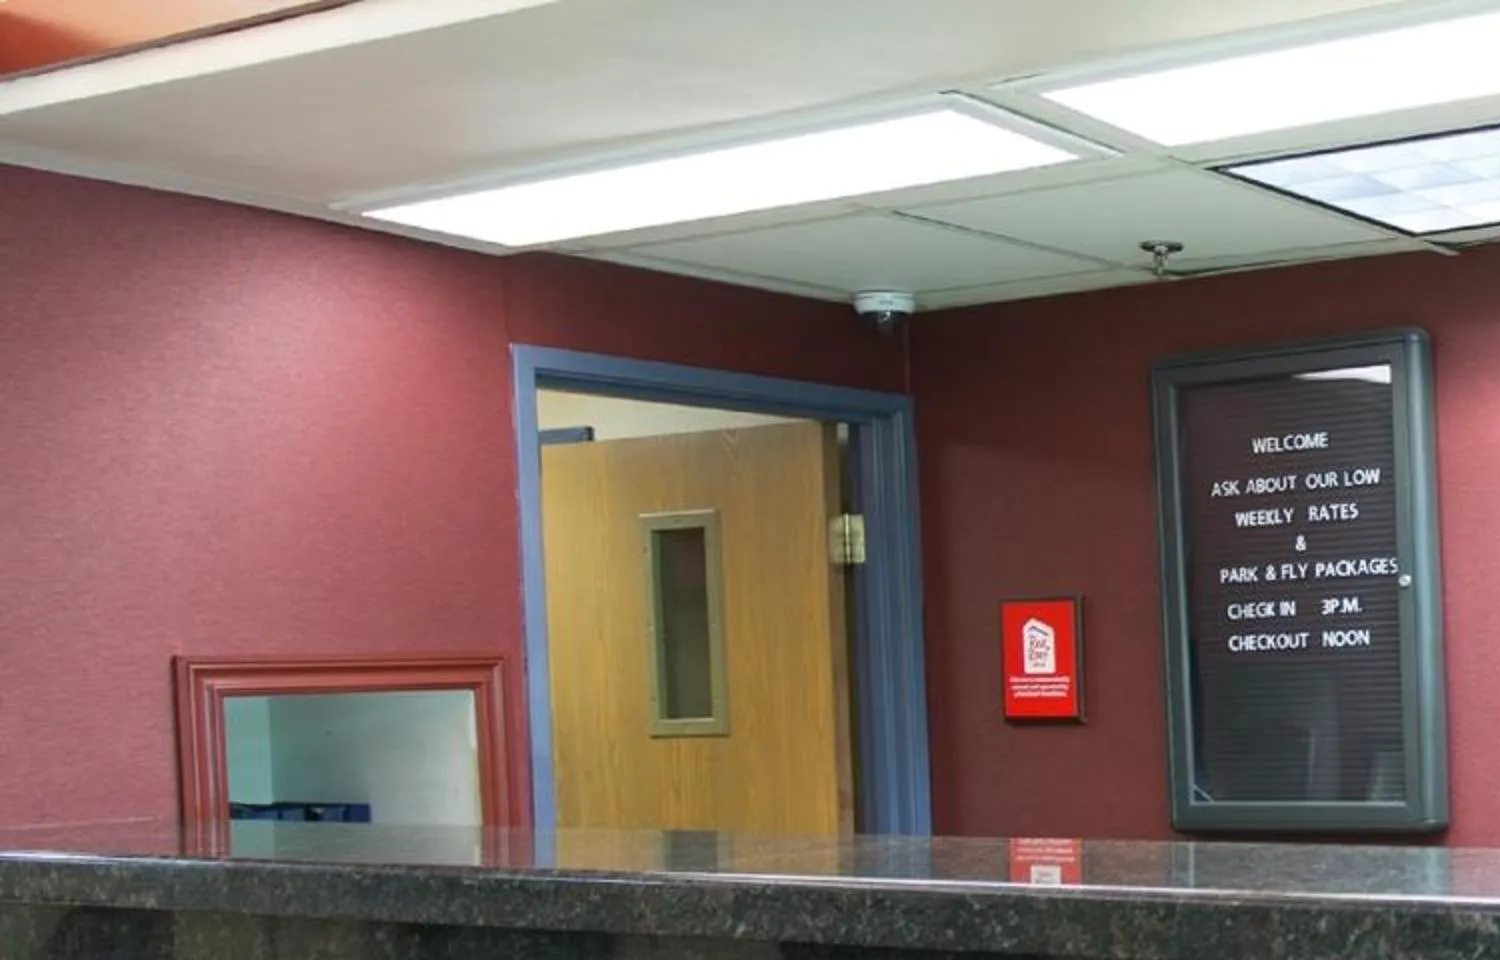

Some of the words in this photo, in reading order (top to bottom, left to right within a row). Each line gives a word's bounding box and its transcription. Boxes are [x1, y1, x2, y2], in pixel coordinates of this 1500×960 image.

[1252, 432, 1329, 453] WELCOME
[1211, 480, 1241, 497] ASK
[1245, 475, 1297, 494] ABOUT
[1305, 471, 1339, 489] OUR
[1344, 468, 1381, 486] LOW
[1235, 507, 1295, 527] WEEKLY
[1308, 502, 1359, 522] RATES
[1295, 535, 1307, 551] &
[1220, 567, 1259, 584] PARK
[1265, 564, 1277, 581] &
[1281, 562, 1309, 580] FLY
[1315, 557, 1399, 577] PACKAGES
[1279, 601, 1296, 617] IN
[1228, 632, 1310, 652] CHECKOUT
[1321, 629, 1371, 648] NOON
